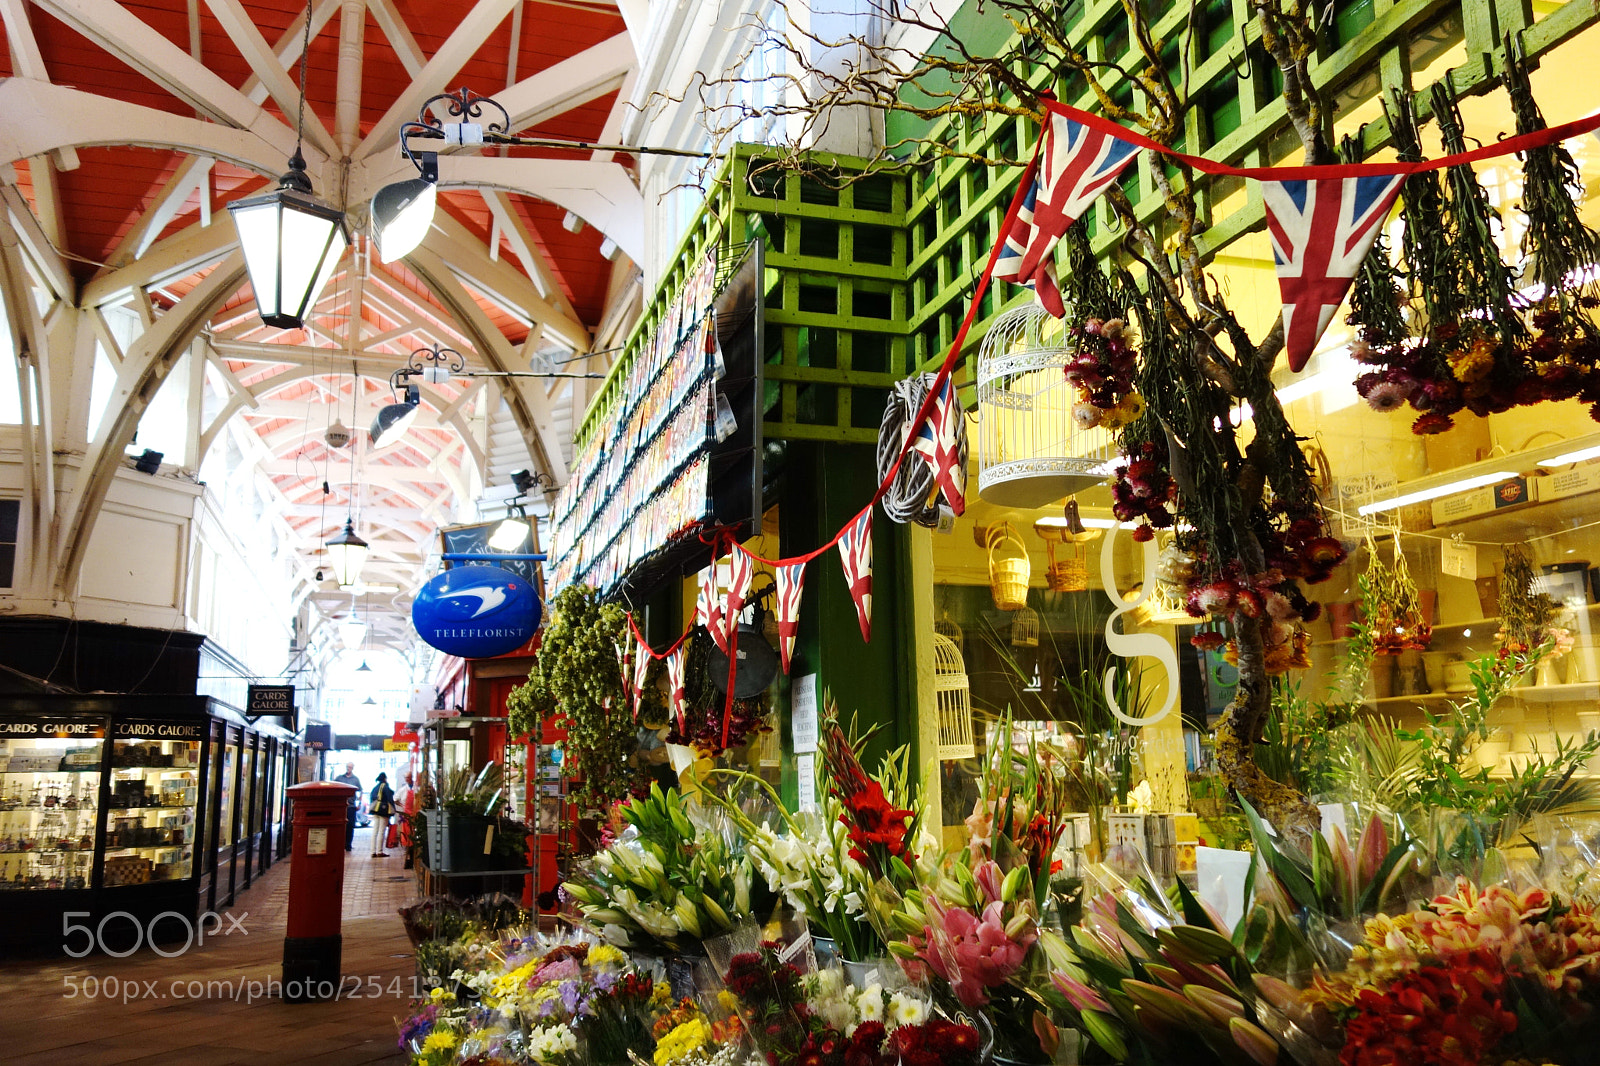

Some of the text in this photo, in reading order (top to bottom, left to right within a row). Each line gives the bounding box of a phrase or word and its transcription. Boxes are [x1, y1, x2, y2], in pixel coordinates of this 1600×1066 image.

[434, 628, 523, 638] TELEFLORIST
[255, 692, 287, 700] CARDS
[252, 701, 289, 709] GALORE
[0, 723, 89, 734] CARDS GALORE
[120, 724, 196, 737] CARDS GALORE
